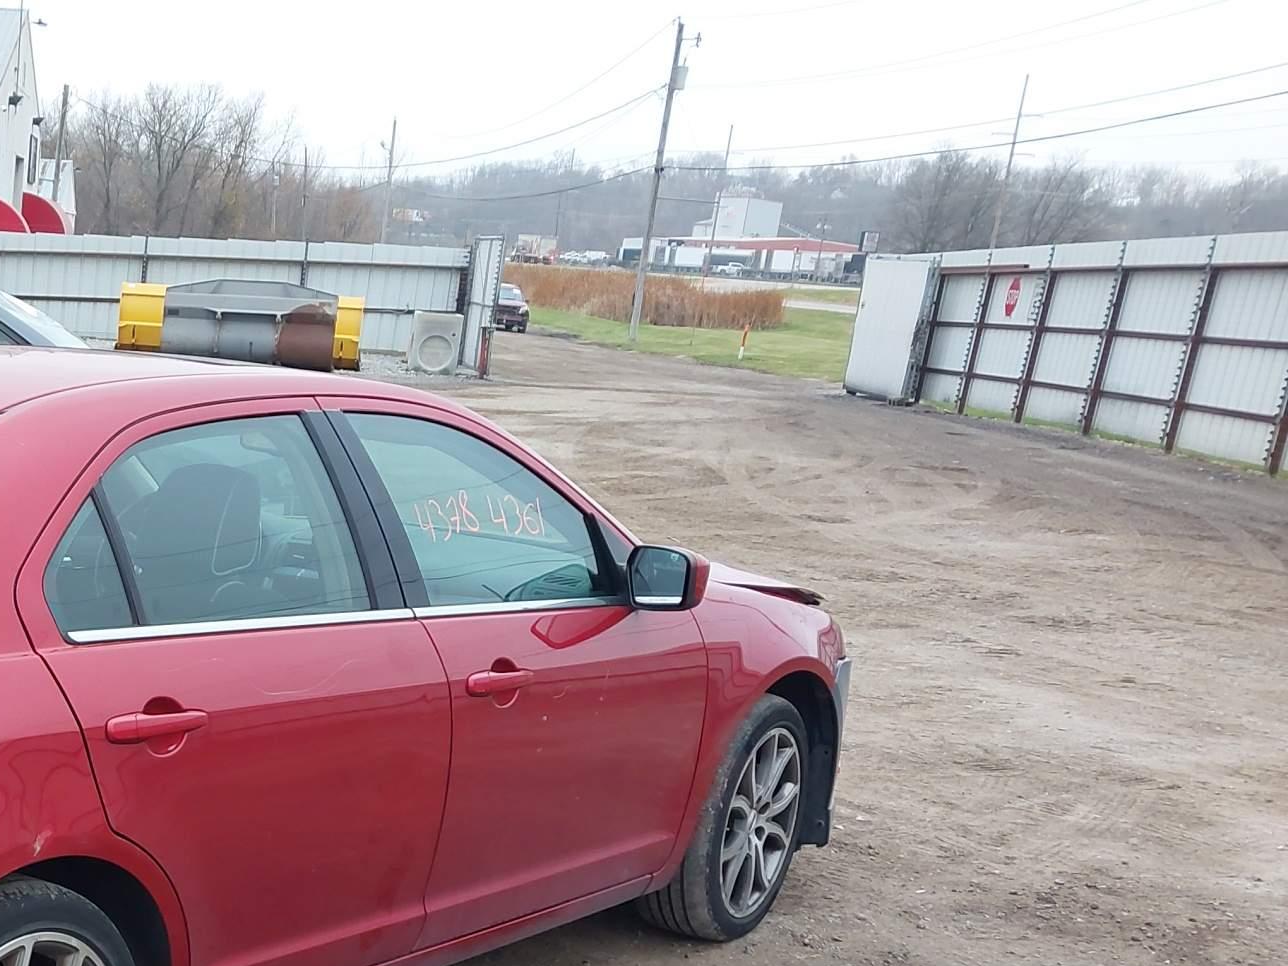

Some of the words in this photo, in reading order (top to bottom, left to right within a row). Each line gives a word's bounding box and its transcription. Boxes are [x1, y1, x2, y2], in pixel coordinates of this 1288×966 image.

[1006, 289, 1020, 305] STOP
[414, 489, 480, 543] 4378
[486, 494, 545, 537] 4361
